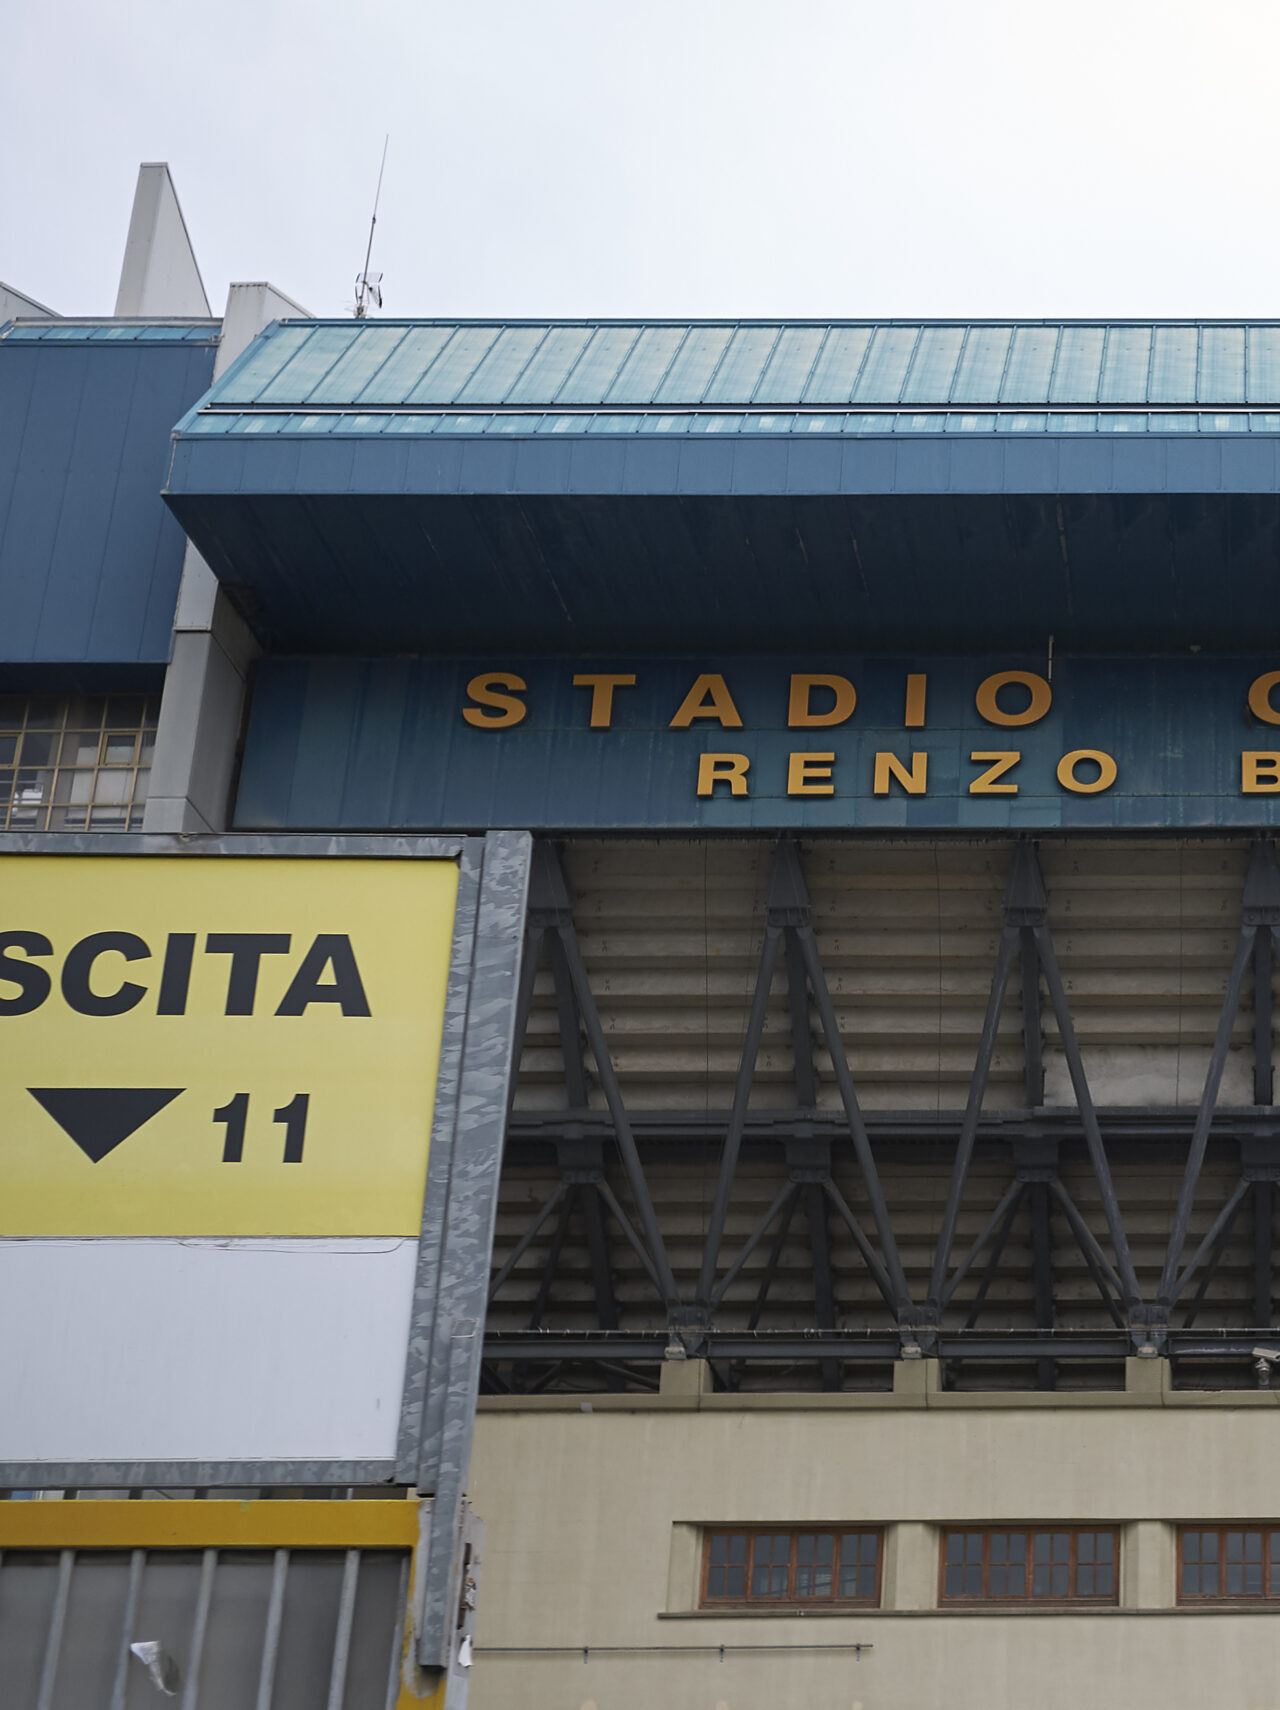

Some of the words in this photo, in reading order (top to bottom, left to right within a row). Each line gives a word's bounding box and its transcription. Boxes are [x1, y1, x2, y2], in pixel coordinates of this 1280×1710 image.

[461, 669, 1053, 729] STADIO
[696, 750, 1118, 795] RENZO
[212, 1092, 311, 1164] 11
